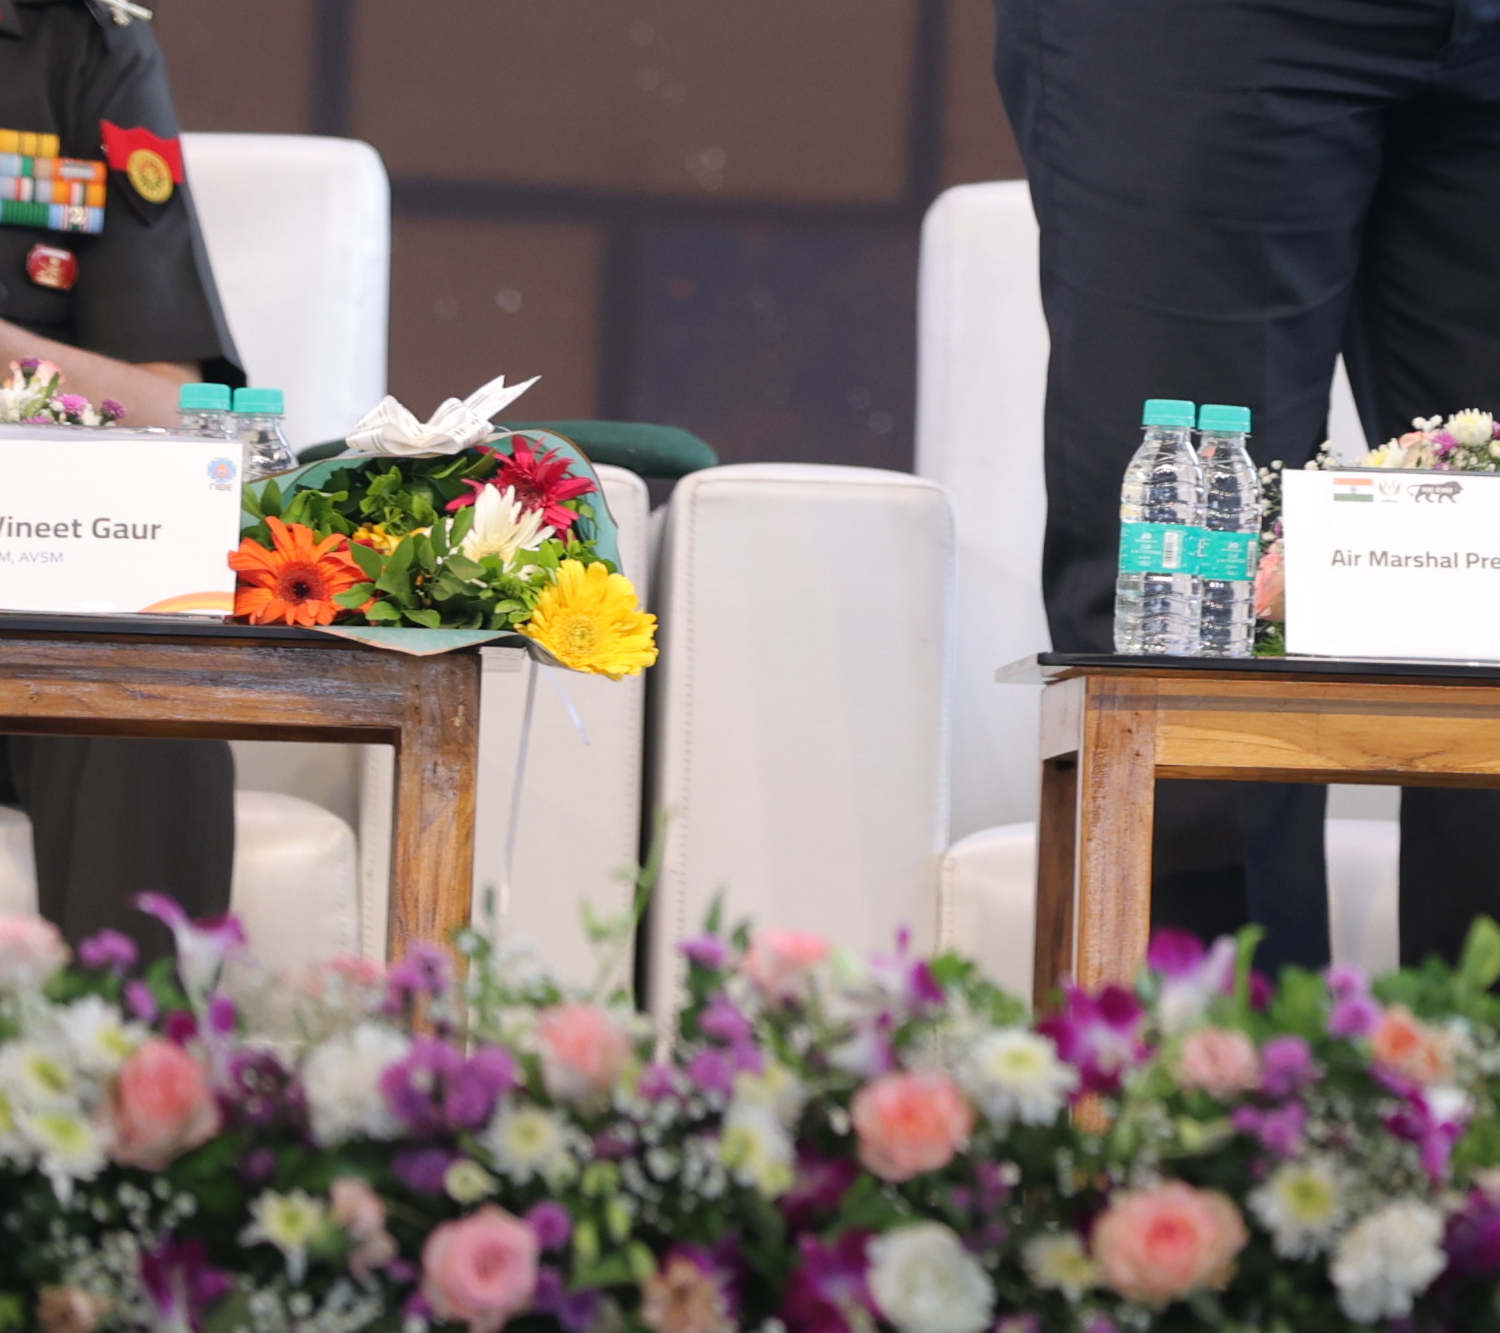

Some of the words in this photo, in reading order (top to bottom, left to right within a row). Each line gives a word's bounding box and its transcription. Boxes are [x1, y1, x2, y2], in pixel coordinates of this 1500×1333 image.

[92, 517, 161, 540] Gaur
[19, 551, 64, 564] AVSM
[1331, 549, 1362, 567] Air
[1369, 550, 1458, 569] Marshal
